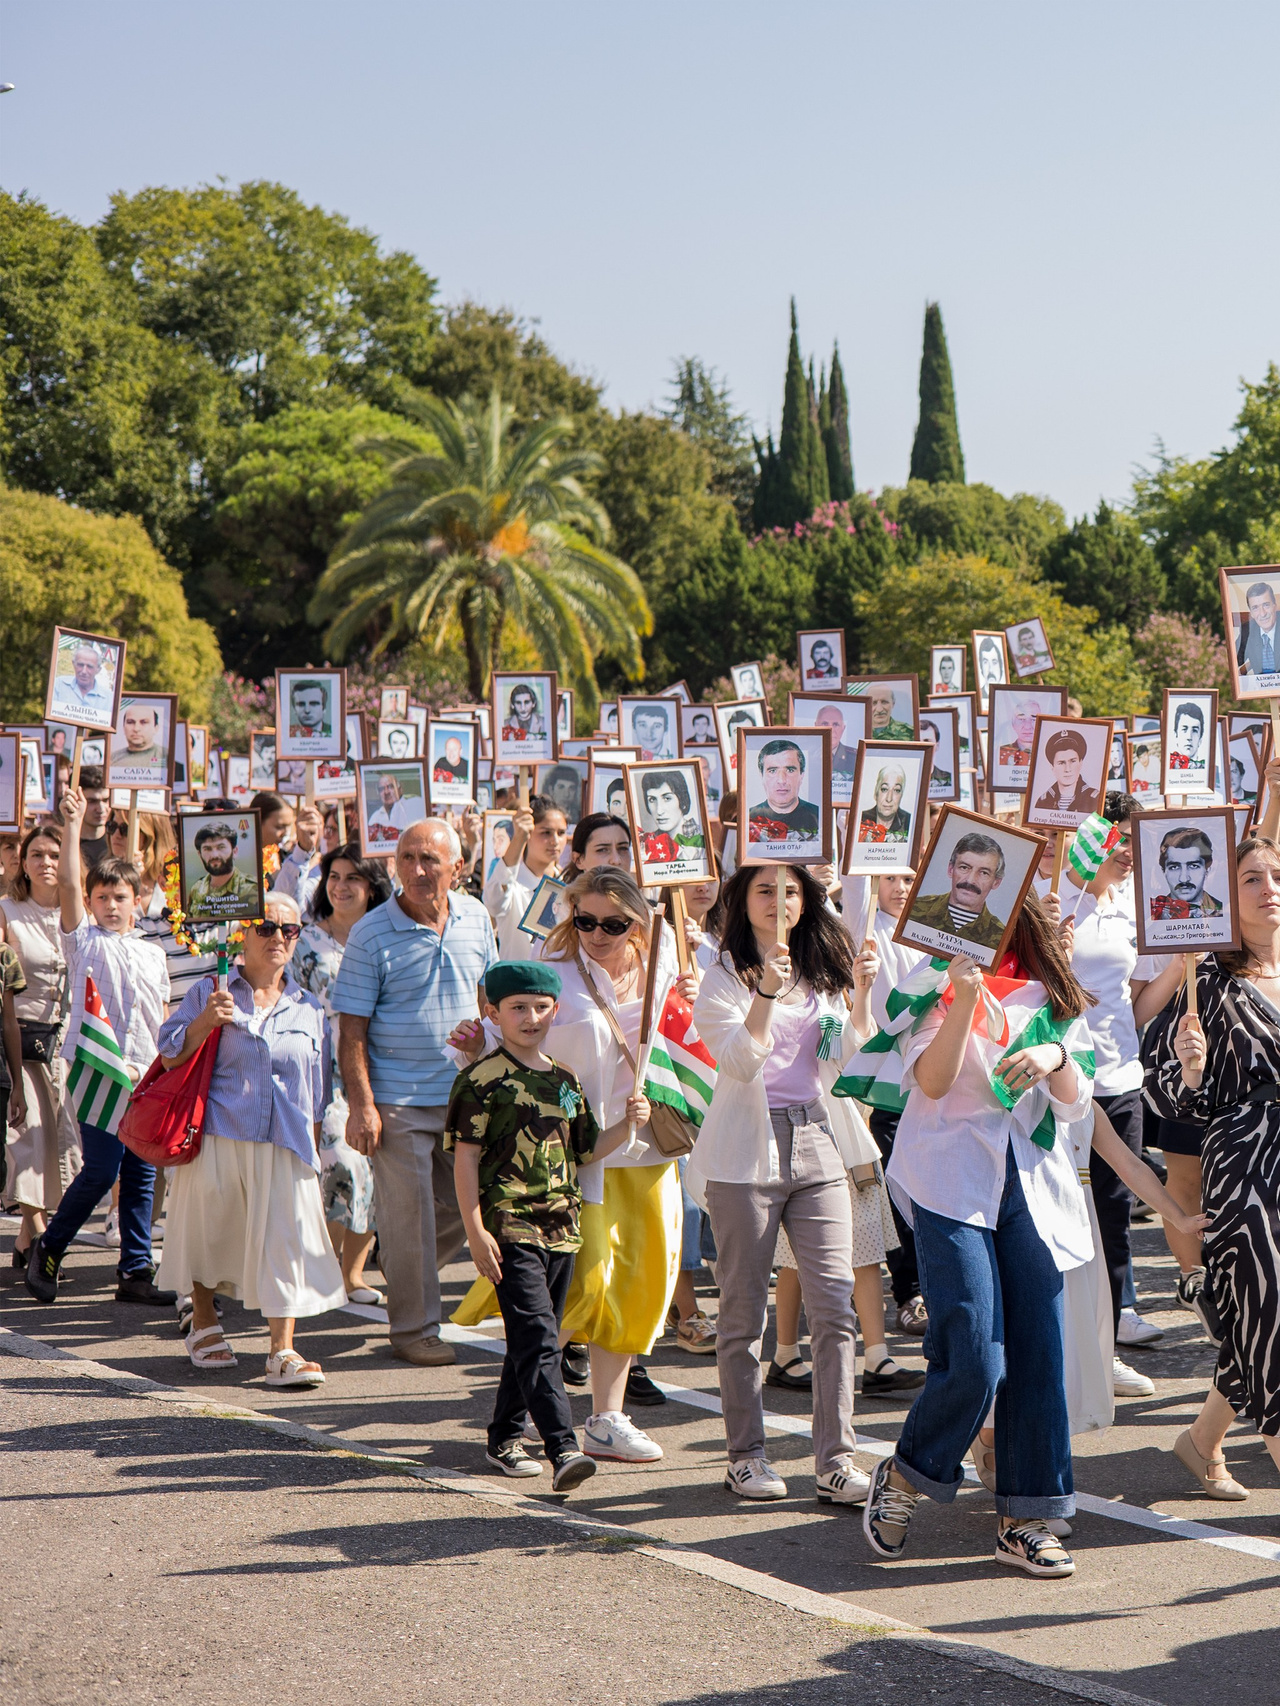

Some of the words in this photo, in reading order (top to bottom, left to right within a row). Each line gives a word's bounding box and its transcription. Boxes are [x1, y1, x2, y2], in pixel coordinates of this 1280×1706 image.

[64, 705, 98, 717] АЗЫНБА
[124, 767, 152, 775] САБУА
[206, 893, 239, 903] Решитба
[213, 902, 249, 910] Георгиевич
[1165, 923, 1210, 931] ШАРМАТАВА
[937, 932, 963, 946] МАТУА
[911, 932, 934, 944] ВАДИК
[936, 941, 986, 962] ЛЕВОНТИЕВИЧ
